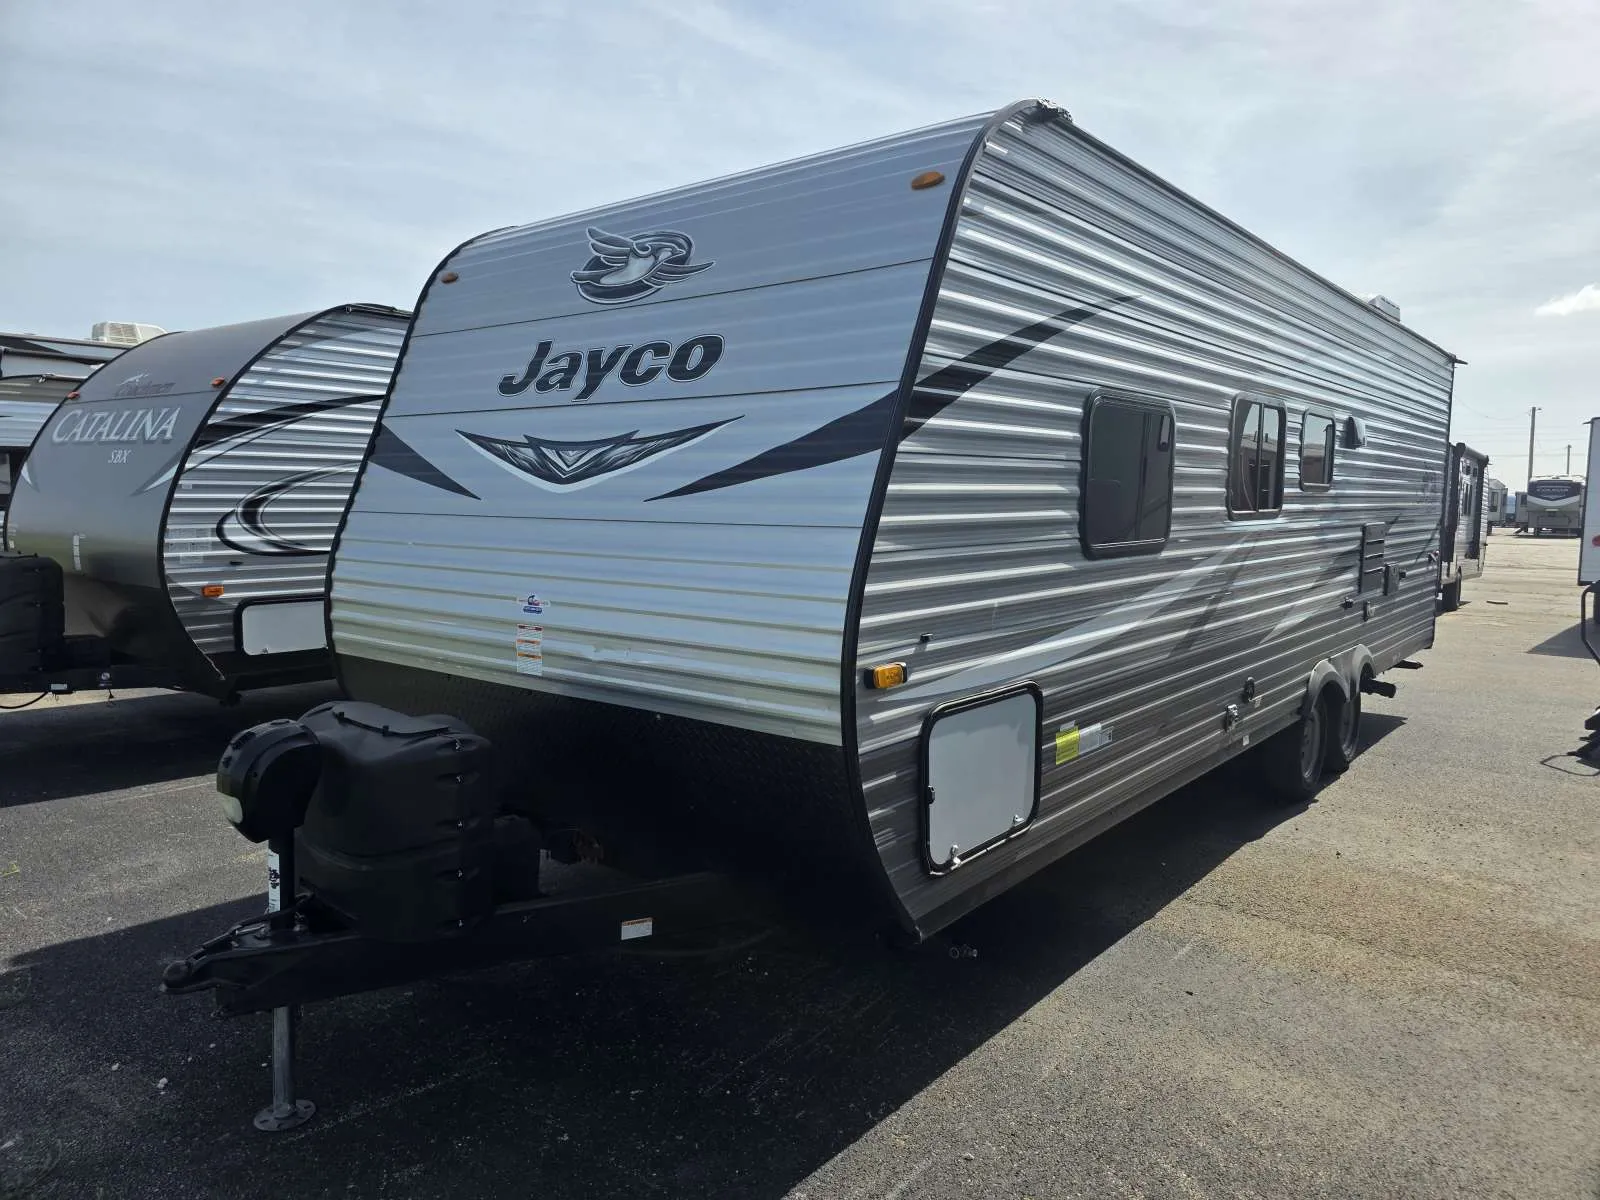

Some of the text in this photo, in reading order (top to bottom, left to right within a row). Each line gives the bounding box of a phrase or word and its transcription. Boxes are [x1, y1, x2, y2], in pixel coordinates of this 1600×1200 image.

[498, 334, 725, 402] Jayco
[52, 406, 180, 443] CATALINA
[107, 449, 132, 464] SBX
